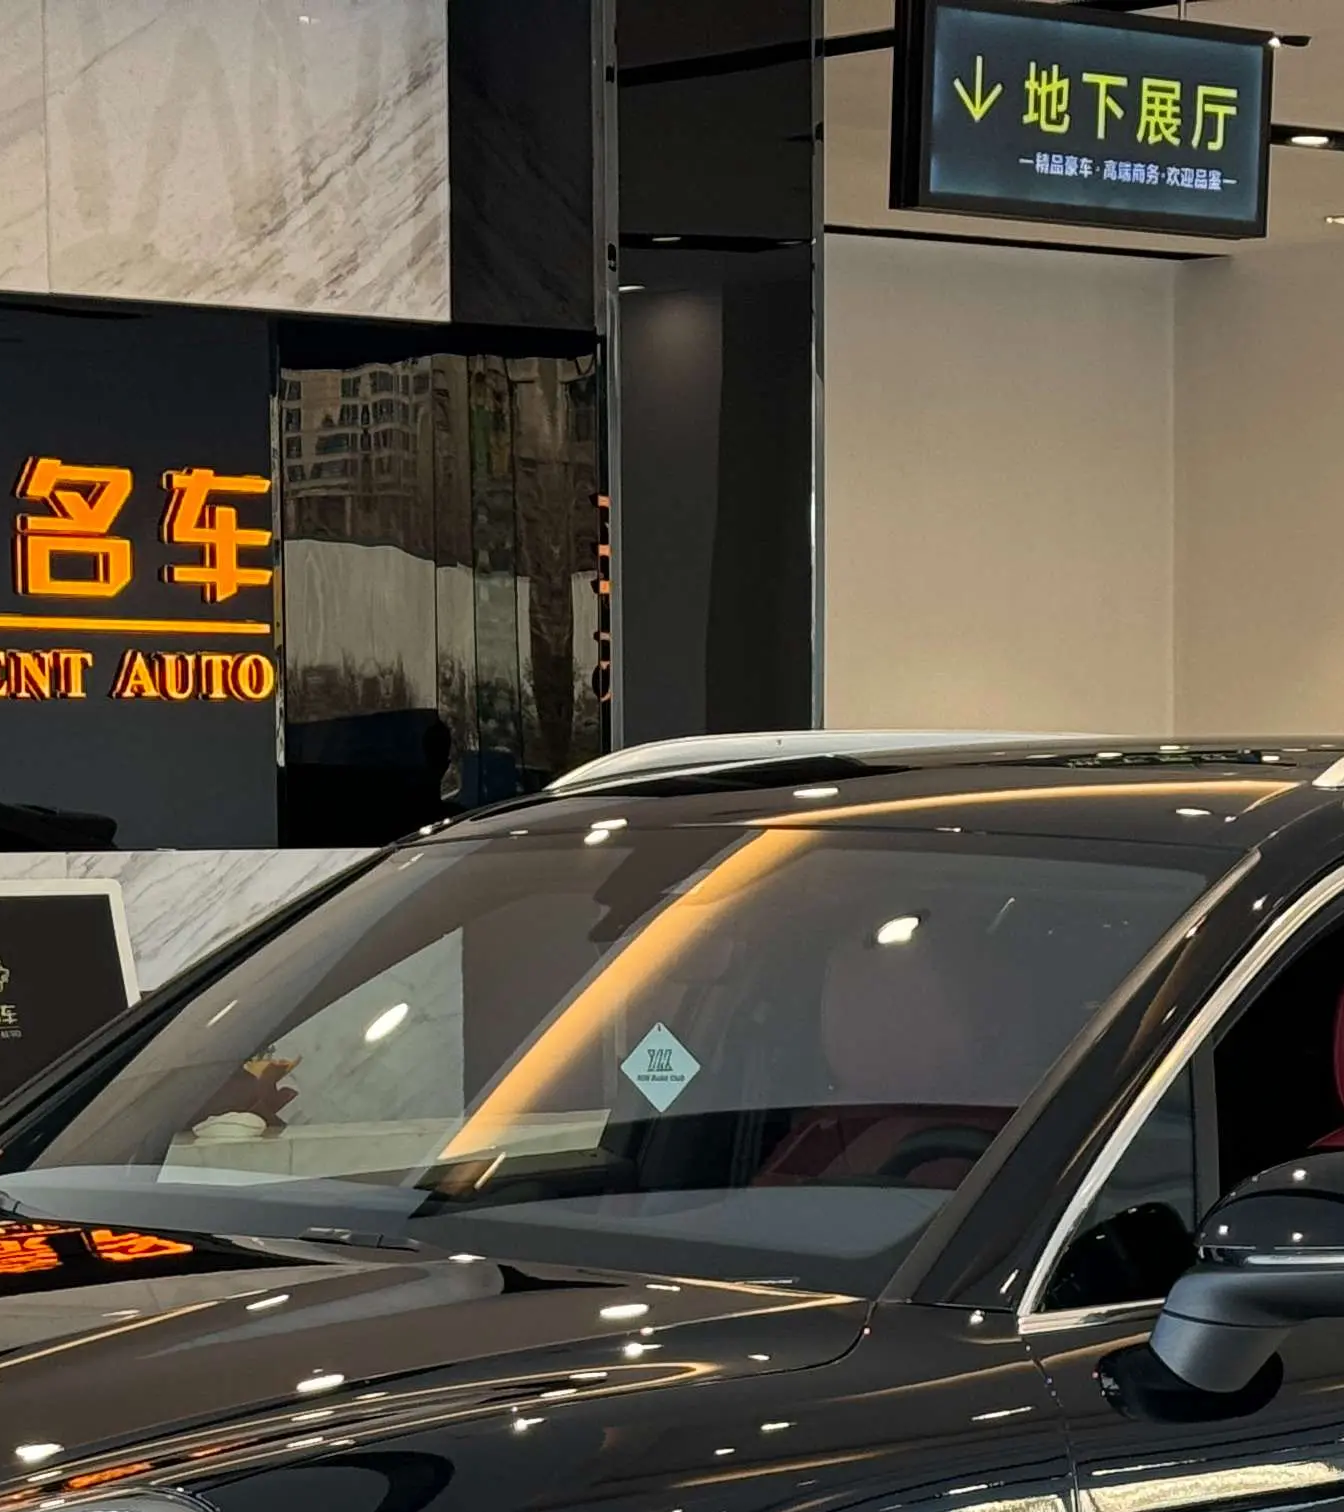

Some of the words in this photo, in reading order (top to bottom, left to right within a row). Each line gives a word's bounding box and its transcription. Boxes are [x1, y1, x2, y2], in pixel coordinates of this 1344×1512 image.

[1022, 61, 1238, 151] 地下展厅
[109, 652, 275, 700] AUTO
